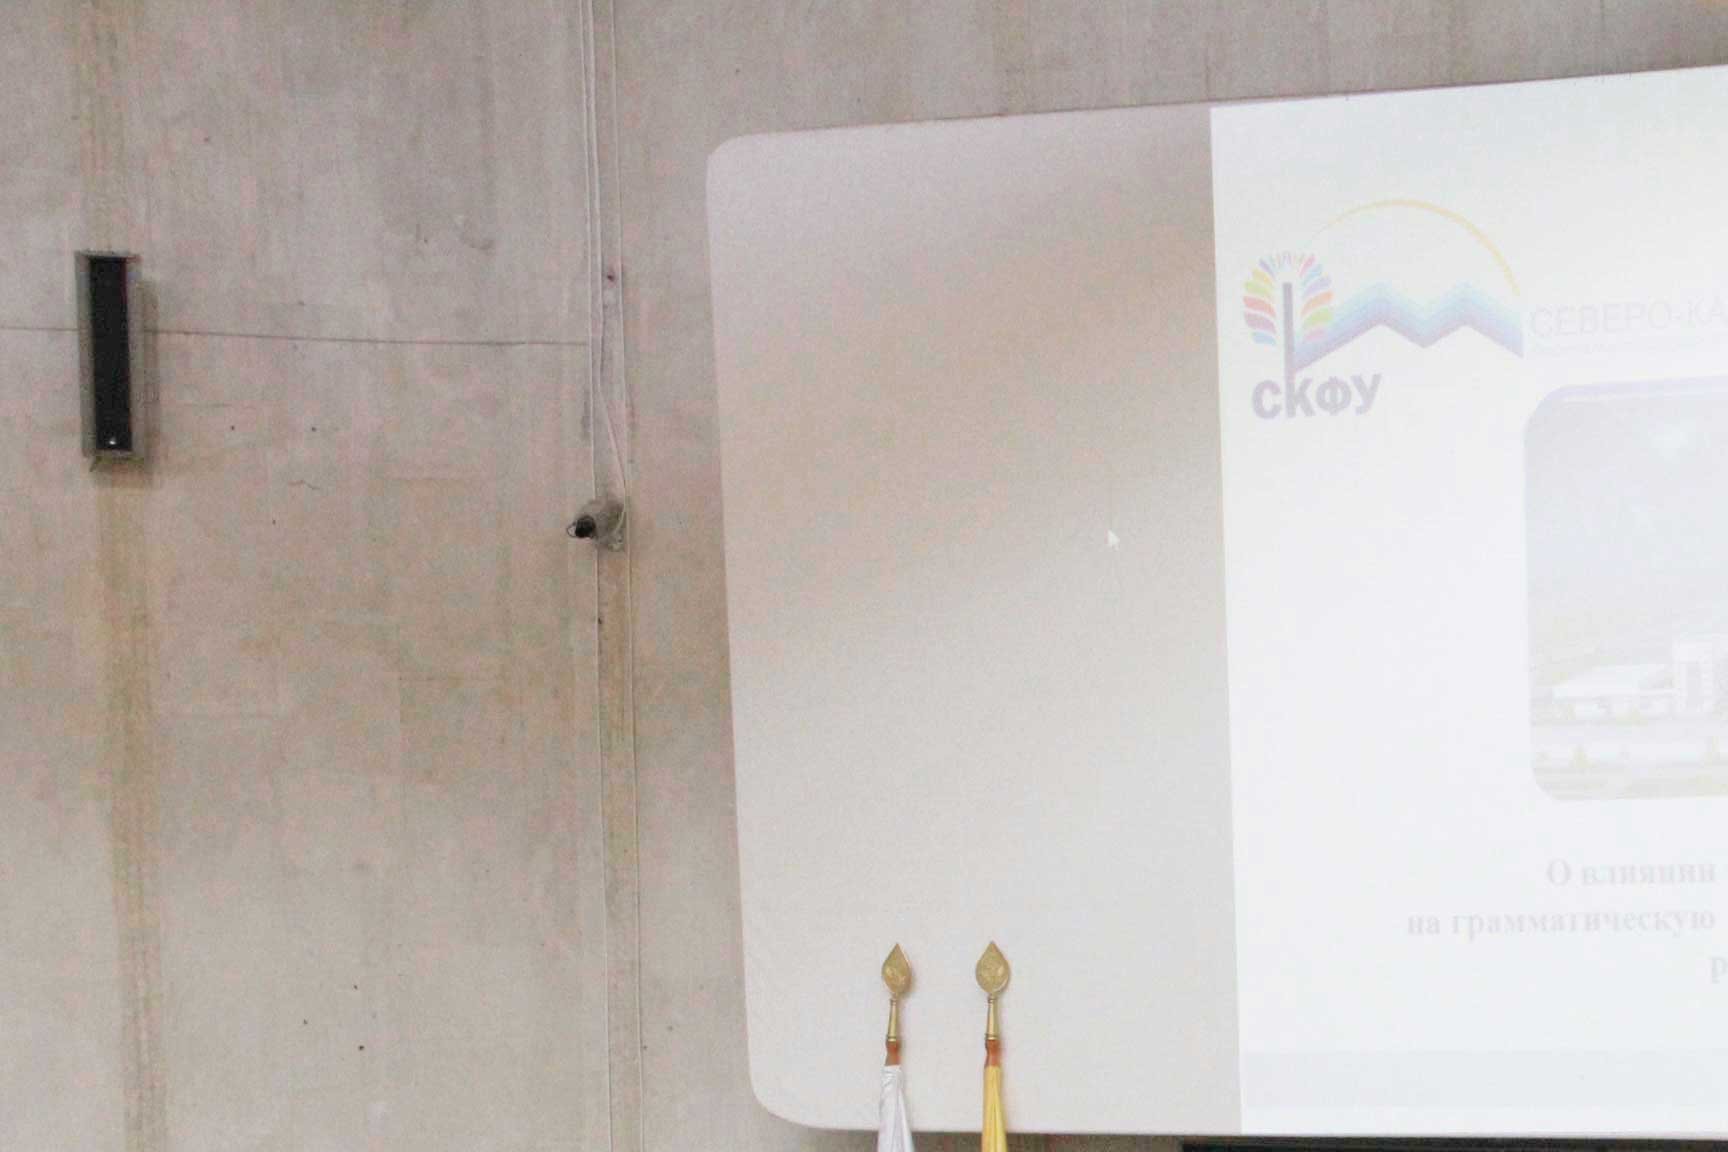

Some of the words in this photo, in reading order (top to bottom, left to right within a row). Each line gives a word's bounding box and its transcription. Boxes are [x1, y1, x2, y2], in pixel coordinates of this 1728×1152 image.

[1545, 857, 1572, 887] О
[1580, 861, 1717, 887] влиянии
[1406, 913, 1441, 936] на
[1450, 908, 1717, 944] грамматическую
